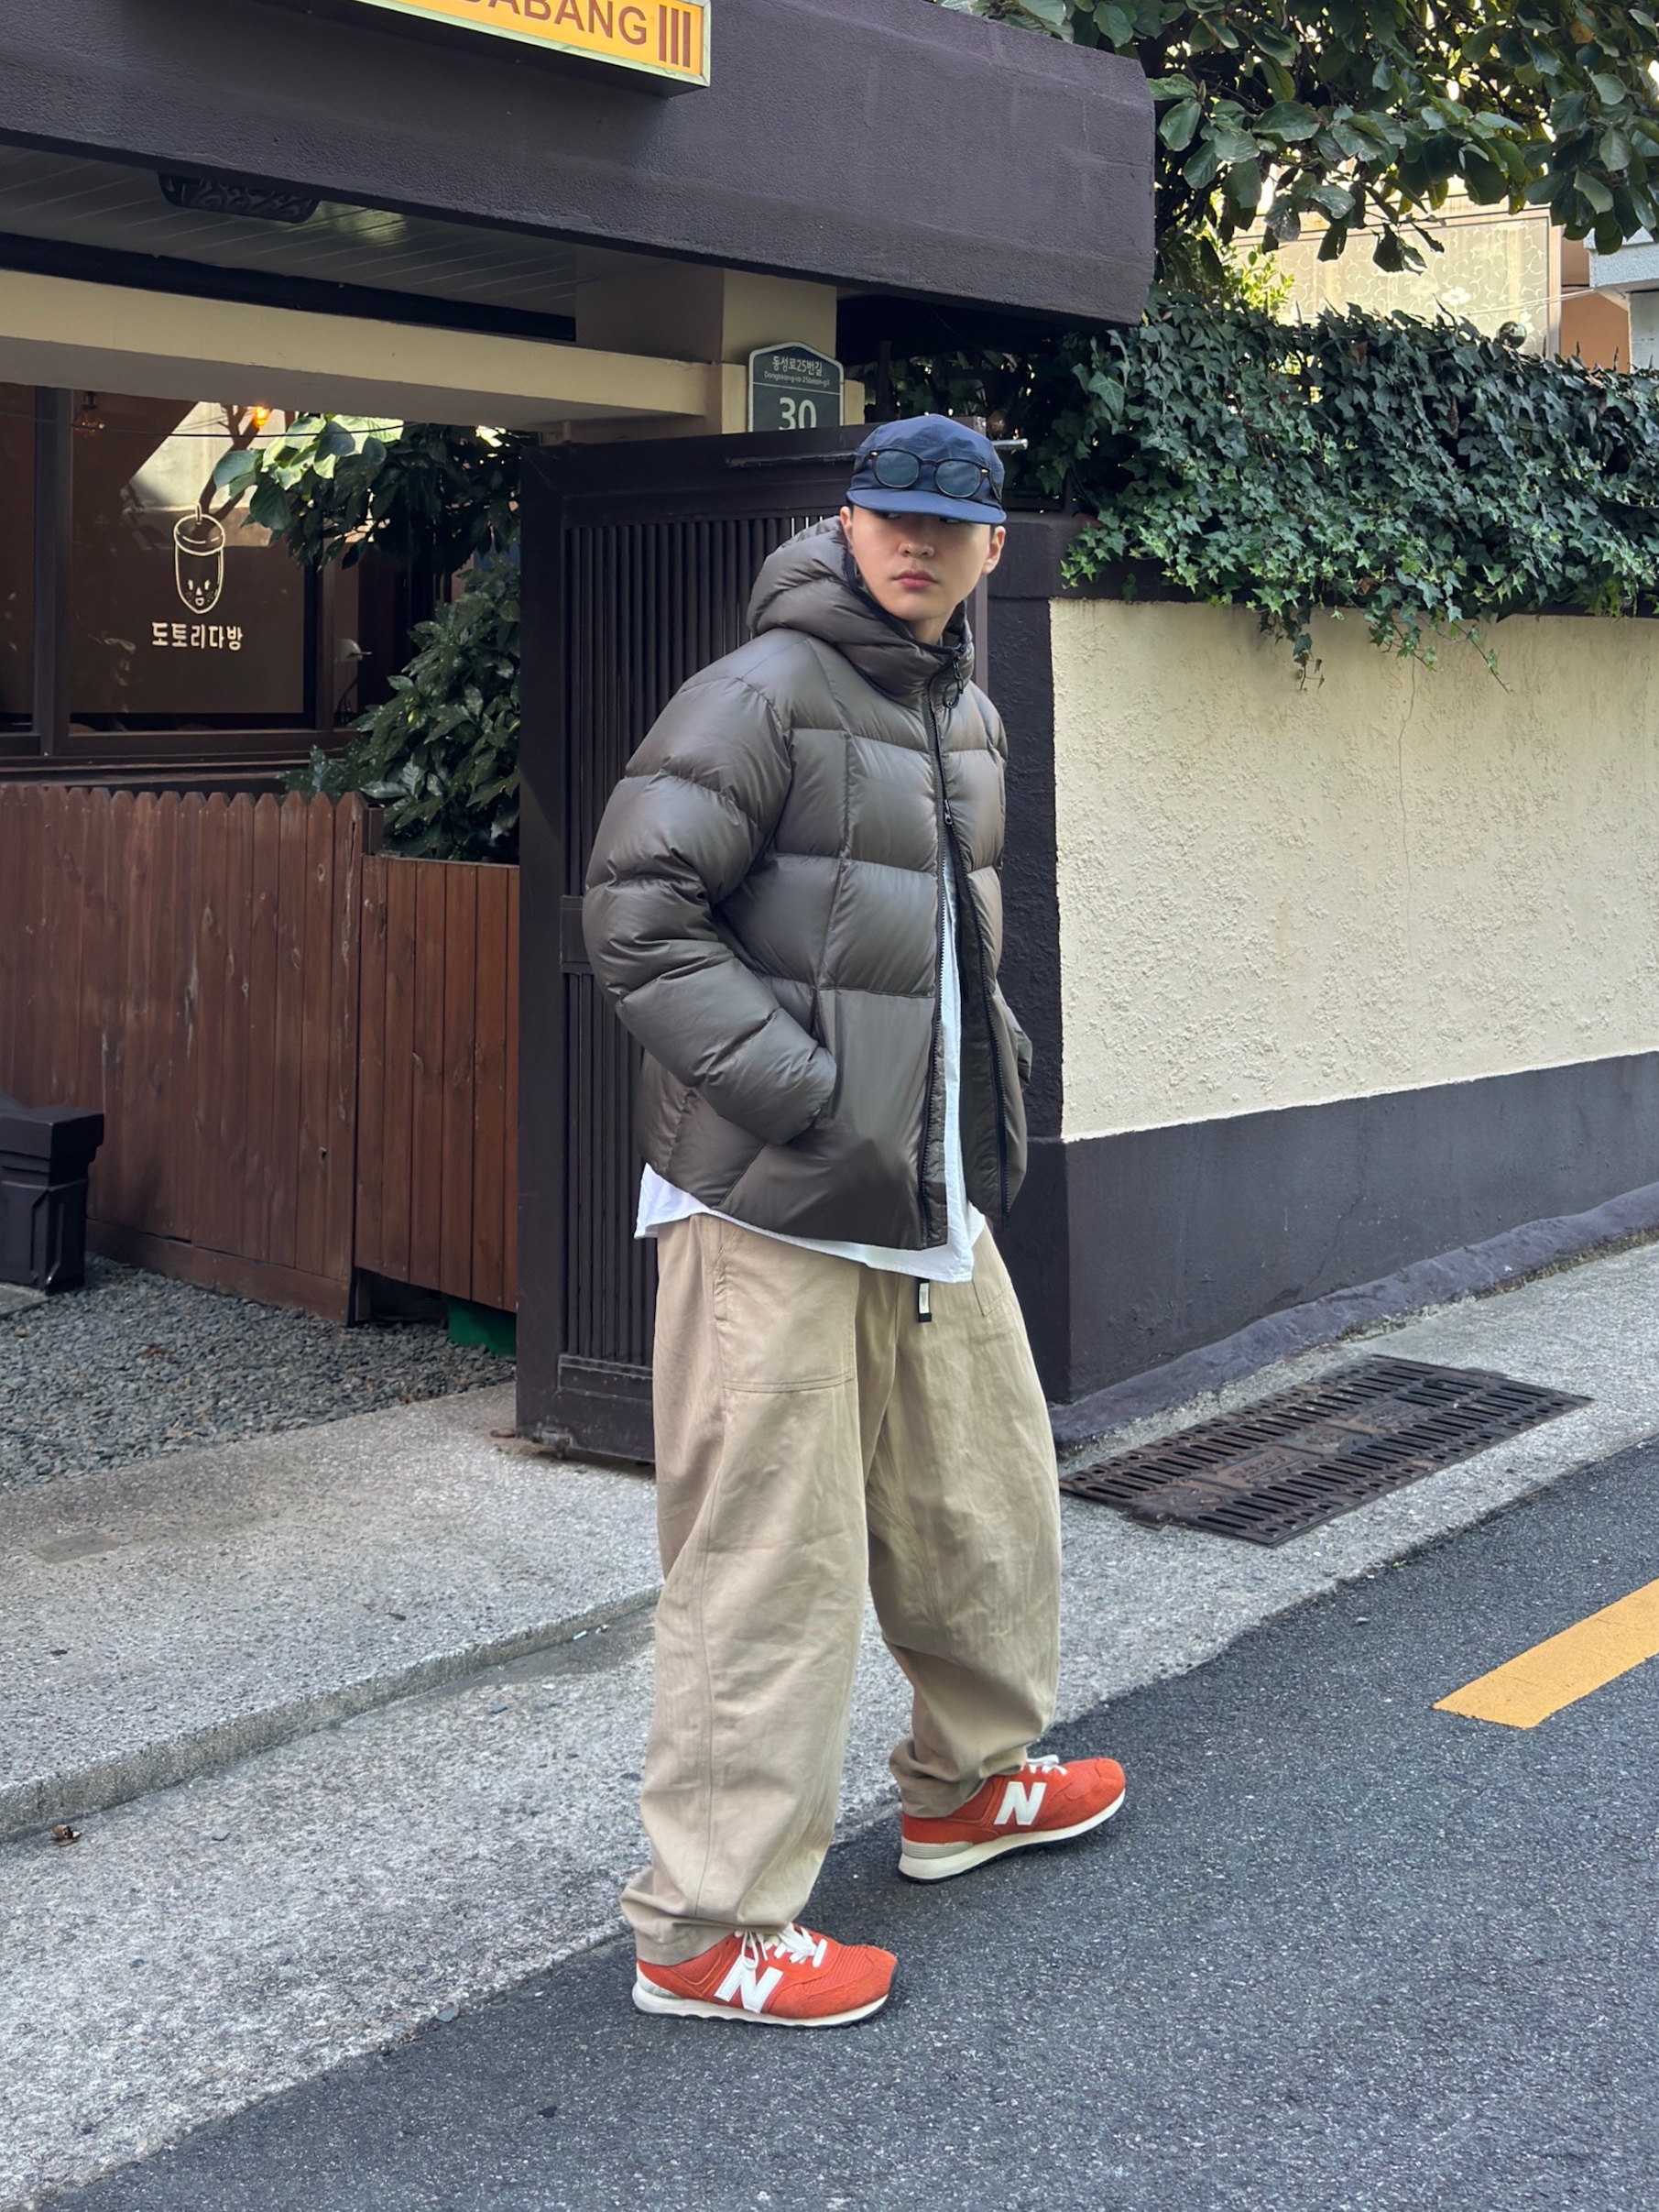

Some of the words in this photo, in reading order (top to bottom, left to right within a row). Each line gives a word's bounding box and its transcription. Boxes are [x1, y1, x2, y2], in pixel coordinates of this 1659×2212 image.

[461, 0, 647, 45] BANG
[773, 356, 823, 376] 동성로25번길
[779, 397, 817, 431] 30
[151, 621, 244, 651] 도토리다방
[993, 1780, 1047, 1826] N
[714, 1955, 784, 2014] N
